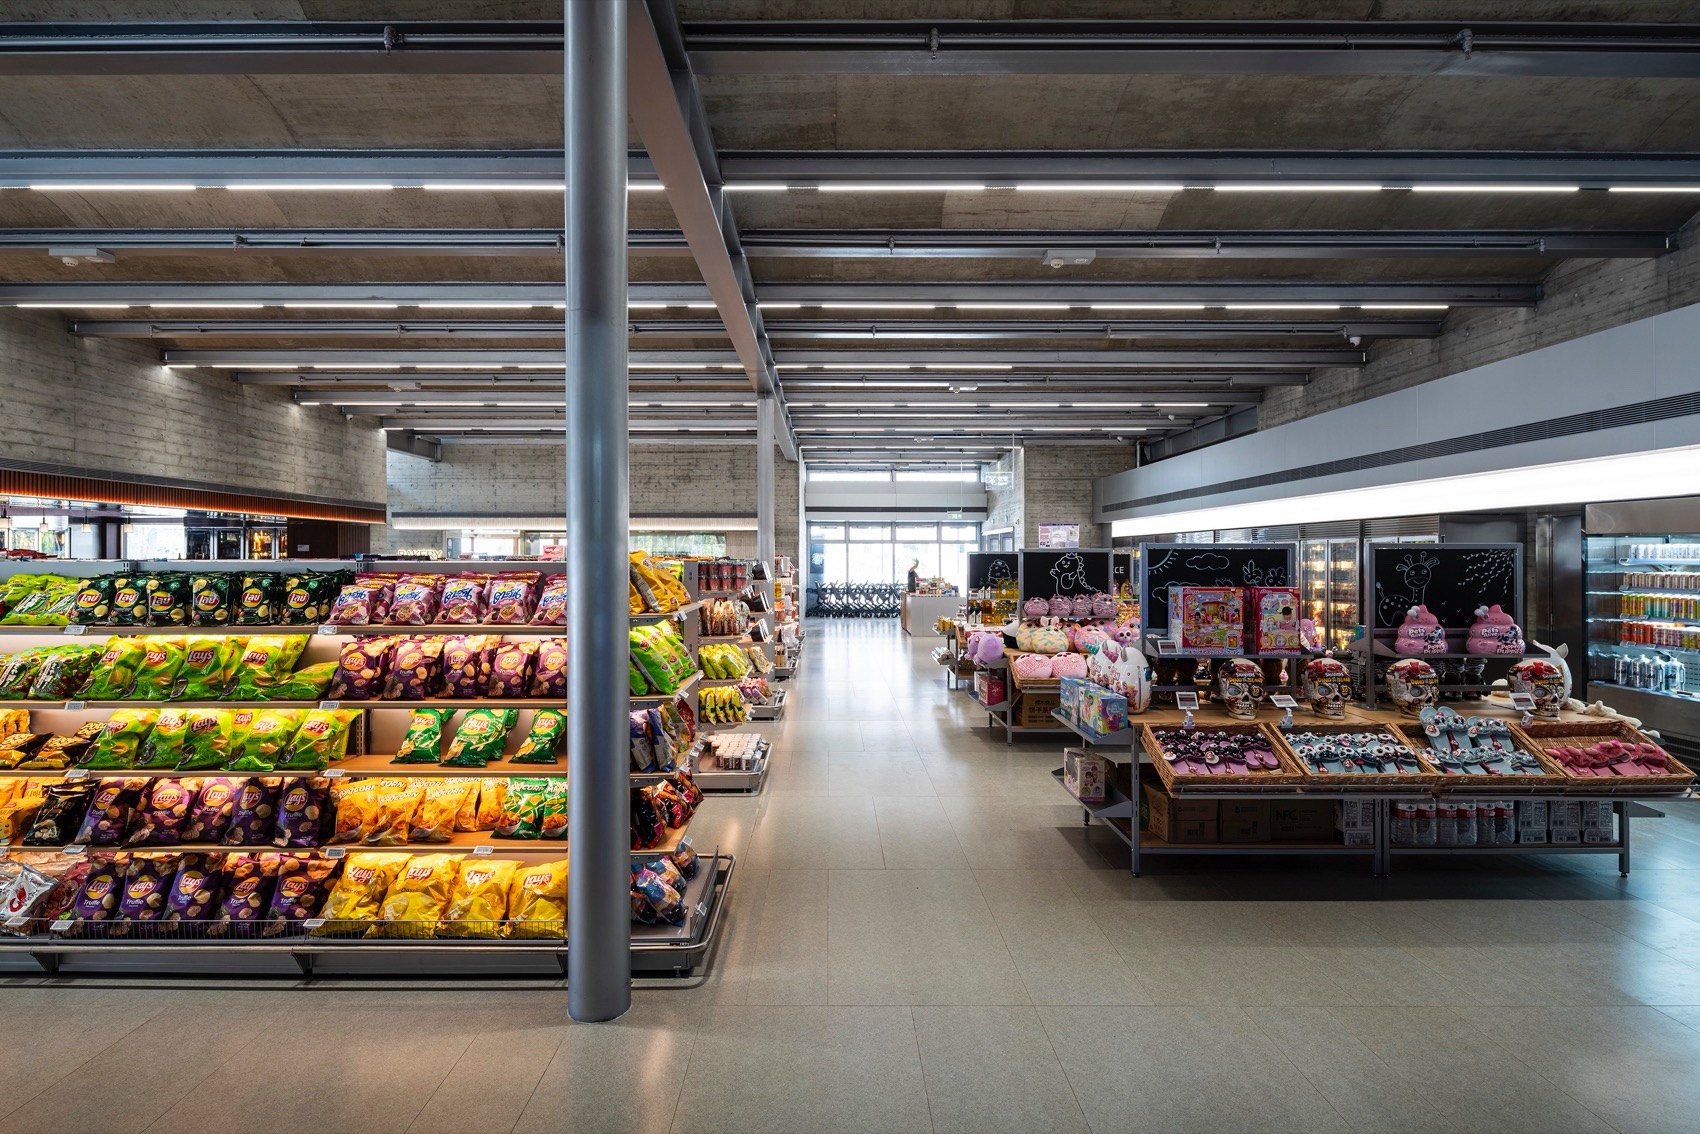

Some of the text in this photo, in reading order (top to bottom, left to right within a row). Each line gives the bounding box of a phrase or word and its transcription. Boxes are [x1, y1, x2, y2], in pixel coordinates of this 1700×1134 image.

[1408, 628, 1425, 636] Pets
[1481, 628, 1498, 636] Pets
[146, 650, 167, 662] ay's
[187, 650, 214, 663] Lay's
[343, 656, 365, 667] Lay's
[155, 715, 184, 731] Lay's
[535, 716, 557, 729] Lay's
[154, 793, 180, 805] Lay's
[206, 790, 231, 803] Lay's
[286, 792, 307, 806] Lay's
[1276, 809, 1298, 821] NFC
[131, 881, 154, 894] Lay's
[180, 876, 203, 889] Lay's
[282, 880, 306, 892] Lay's
